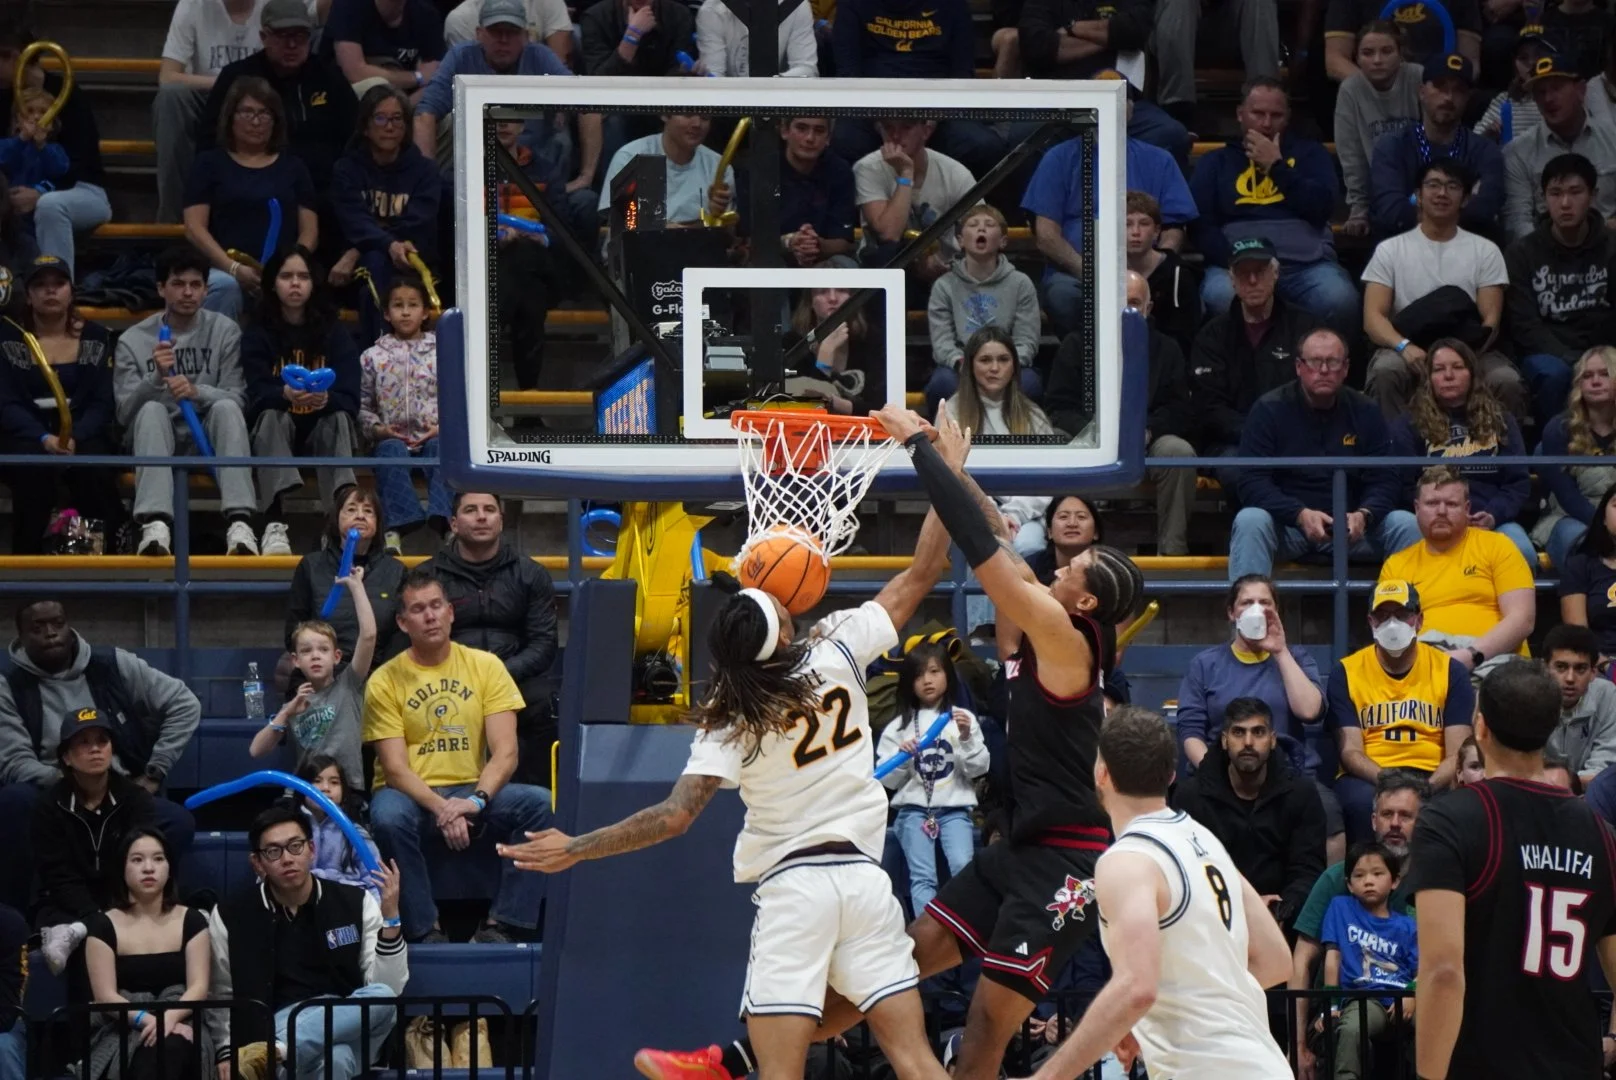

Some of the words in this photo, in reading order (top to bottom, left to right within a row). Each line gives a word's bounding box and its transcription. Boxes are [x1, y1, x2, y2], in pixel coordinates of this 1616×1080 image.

[867, 23, 907, 38] GOLDEN
[908, 26, 942, 39] BEARS
[875, 16, 934, 29] CALIFORNIA
[1447, 55, 1463, 71] C
[1536, 57, 1553, 75] C
[487, 449, 551, 464] SPALDING
[407, 678, 474, 710] GOLDEN
[78, 708, 97, 722] Cal
[785, 685, 863, 769] 22
[1360, 699, 1444, 730] CALIFORNIA
[417, 737, 469, 756] BEARS
[1520, 844, 1593, 880] KHALIFA
[1204, 863, 1232, 932] 8
[1347, 924, 1398, 956] CURRY
[1523, 881, 1593, 981] 15
